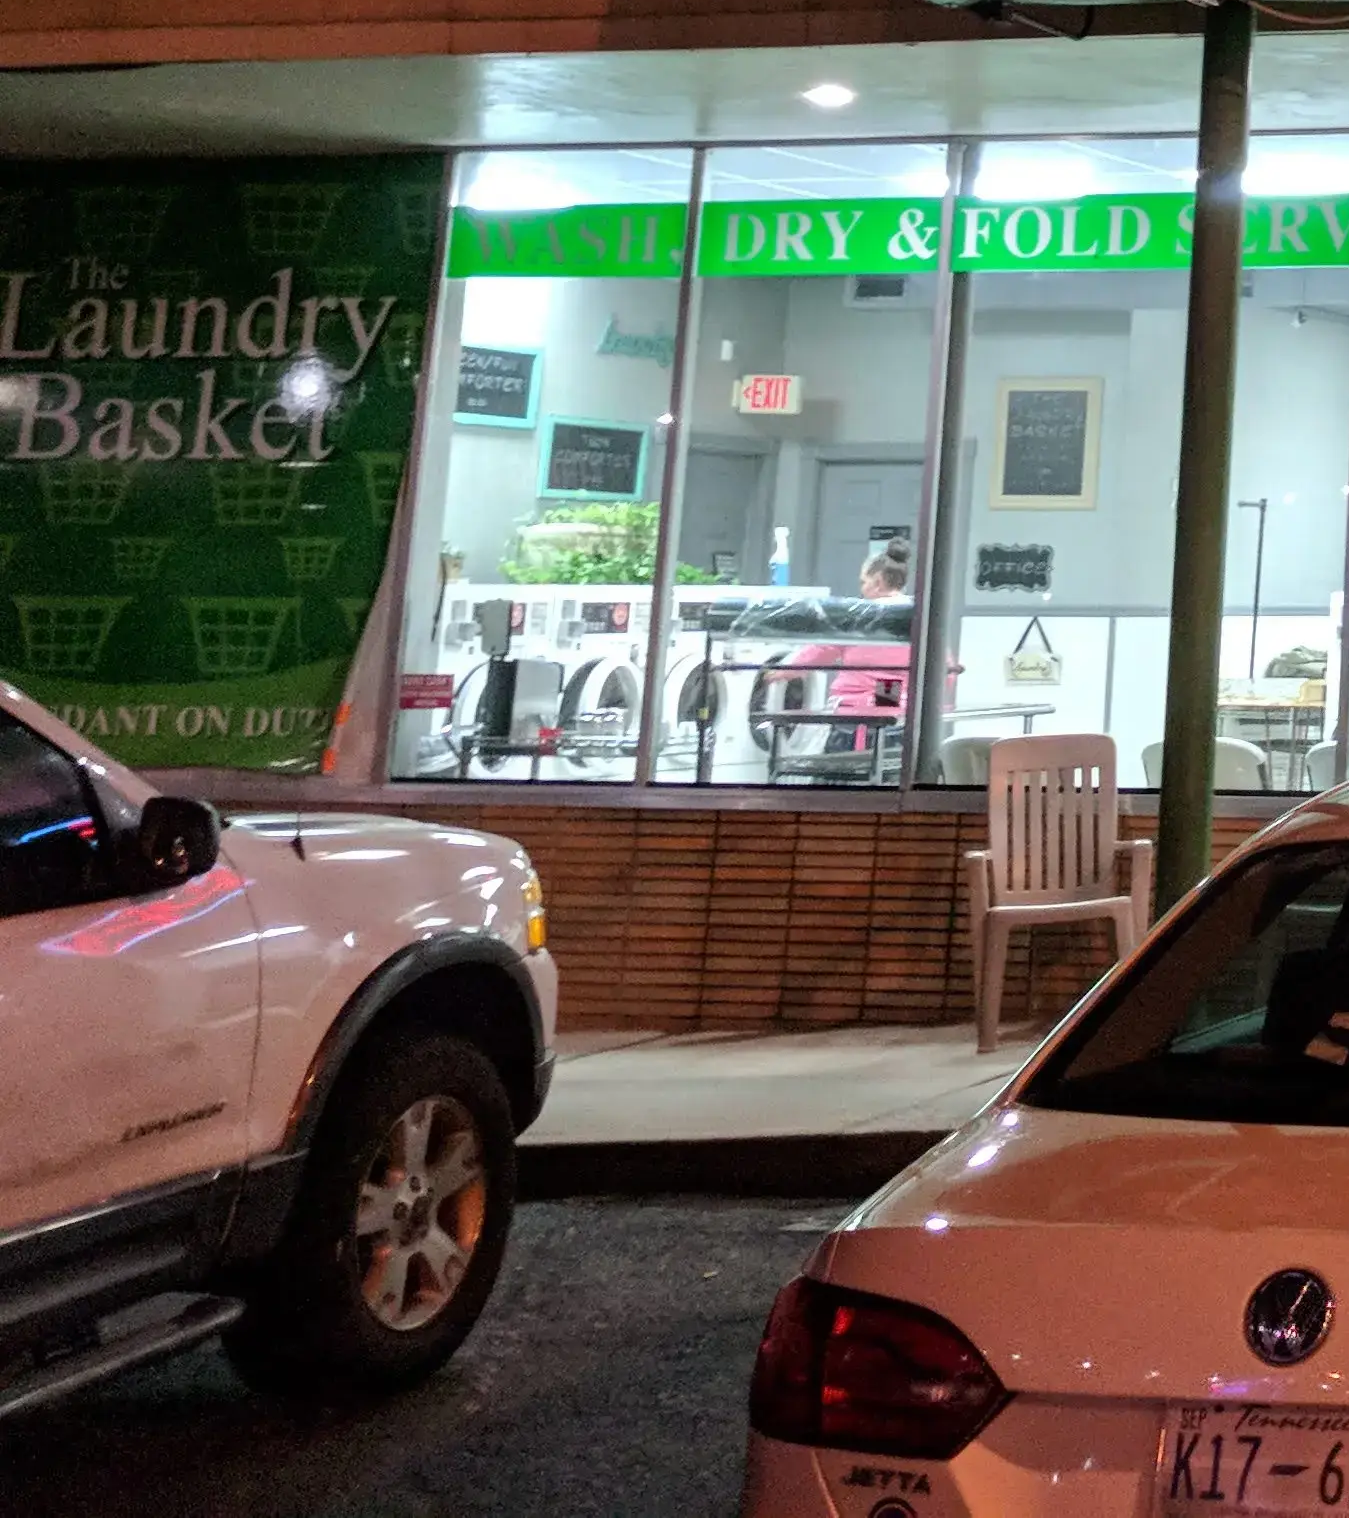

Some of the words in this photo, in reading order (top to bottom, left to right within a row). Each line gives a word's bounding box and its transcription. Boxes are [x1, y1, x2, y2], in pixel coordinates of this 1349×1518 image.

[722, 209, 865, 263] DRY
[886, 206, 940, 262] &
[957, 204, 1152, 259] FOLD
[67, 256, 130, 291] The
[0, 267, 398, 385] Laundry
[752, 377, 792, 409] EXIT
[175, 705, 234, 738] ON
